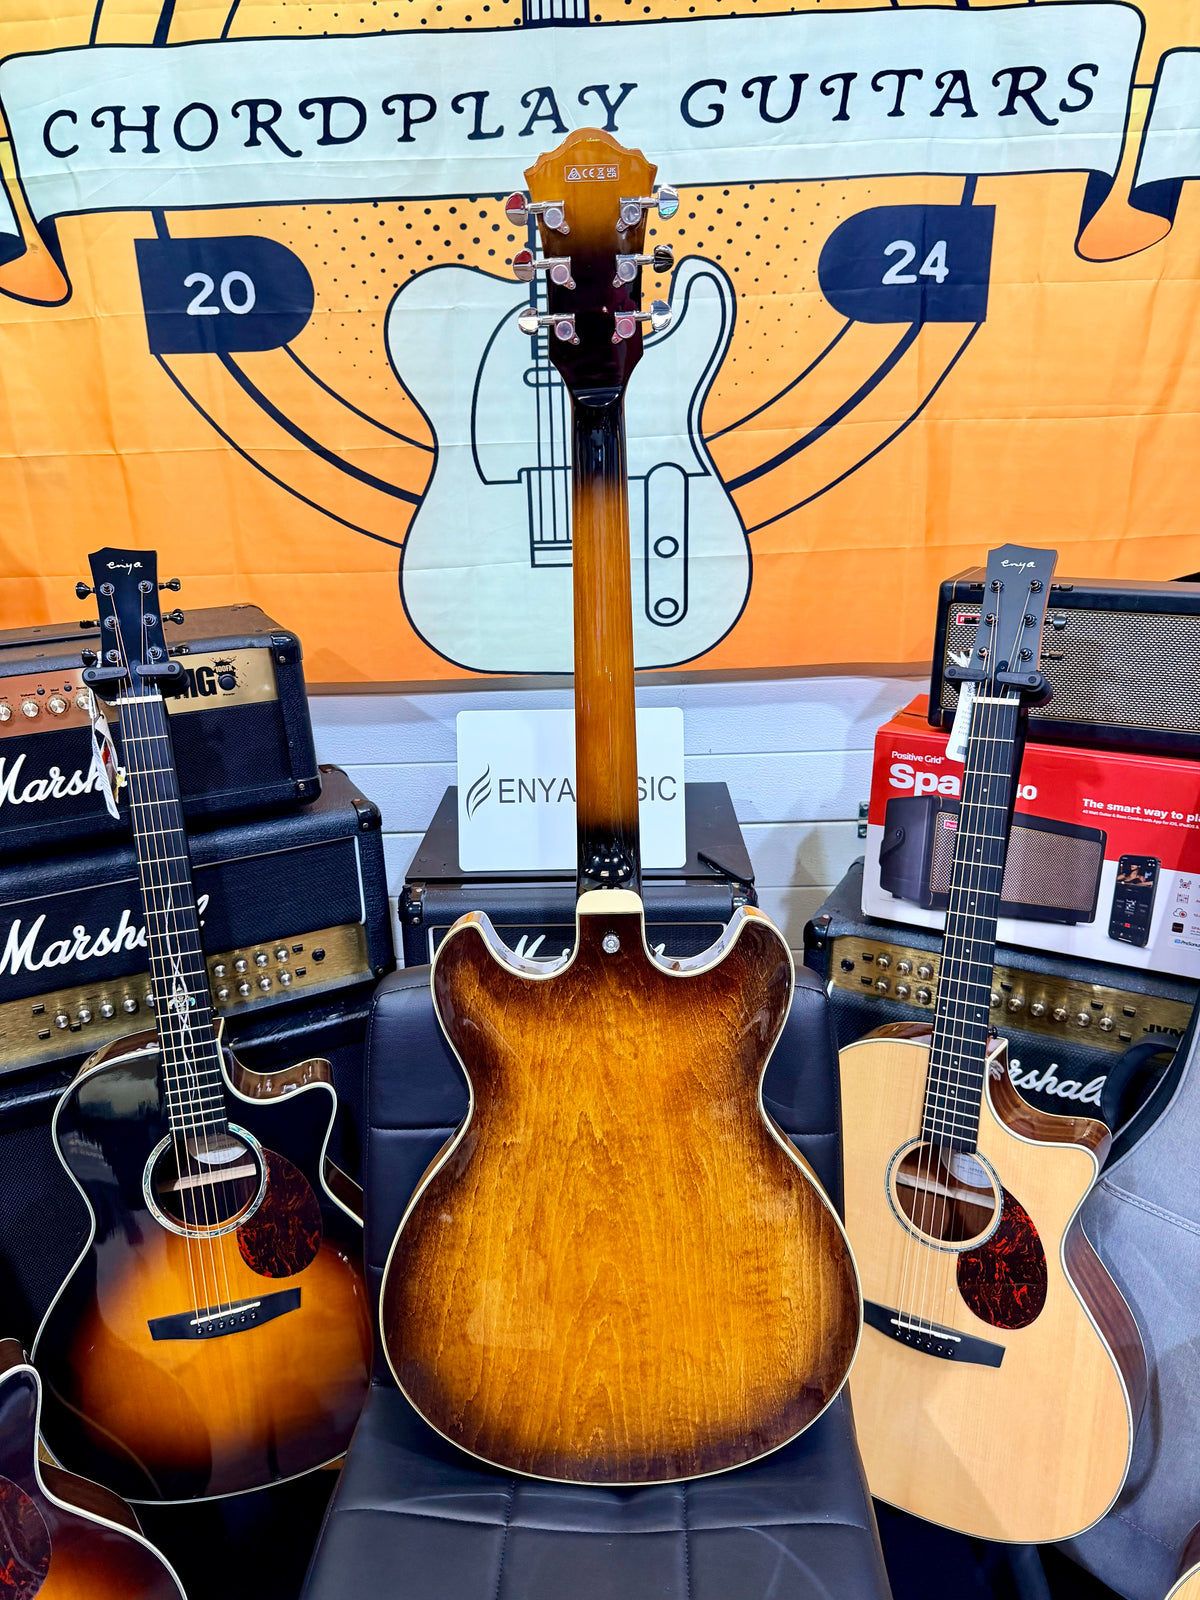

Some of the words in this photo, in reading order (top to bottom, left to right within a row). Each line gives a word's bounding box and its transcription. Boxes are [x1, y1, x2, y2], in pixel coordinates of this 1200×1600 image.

[43, 83, 637, 157] CHORDPLAY
[680, 63, 1099, 128] GUITARS
[882, 240, 949, 284] 24
[183, 270, 256, 316] 20
[1000, 559, 1036, 575] enya
[891, 750, 924, 762] Positive
[498, 777, 576, 804] ENYA
[637, 776, 677, 802] SIC
[888, 763, 961, 797] Spa
[1082, 798, 1104, 809] The
[1106, 803, 1141, 815] smart
[1144, 808, 1169, 820] way
[1171, 810, 1184, 820] to
[0, 894, 210, 975] Marsh
